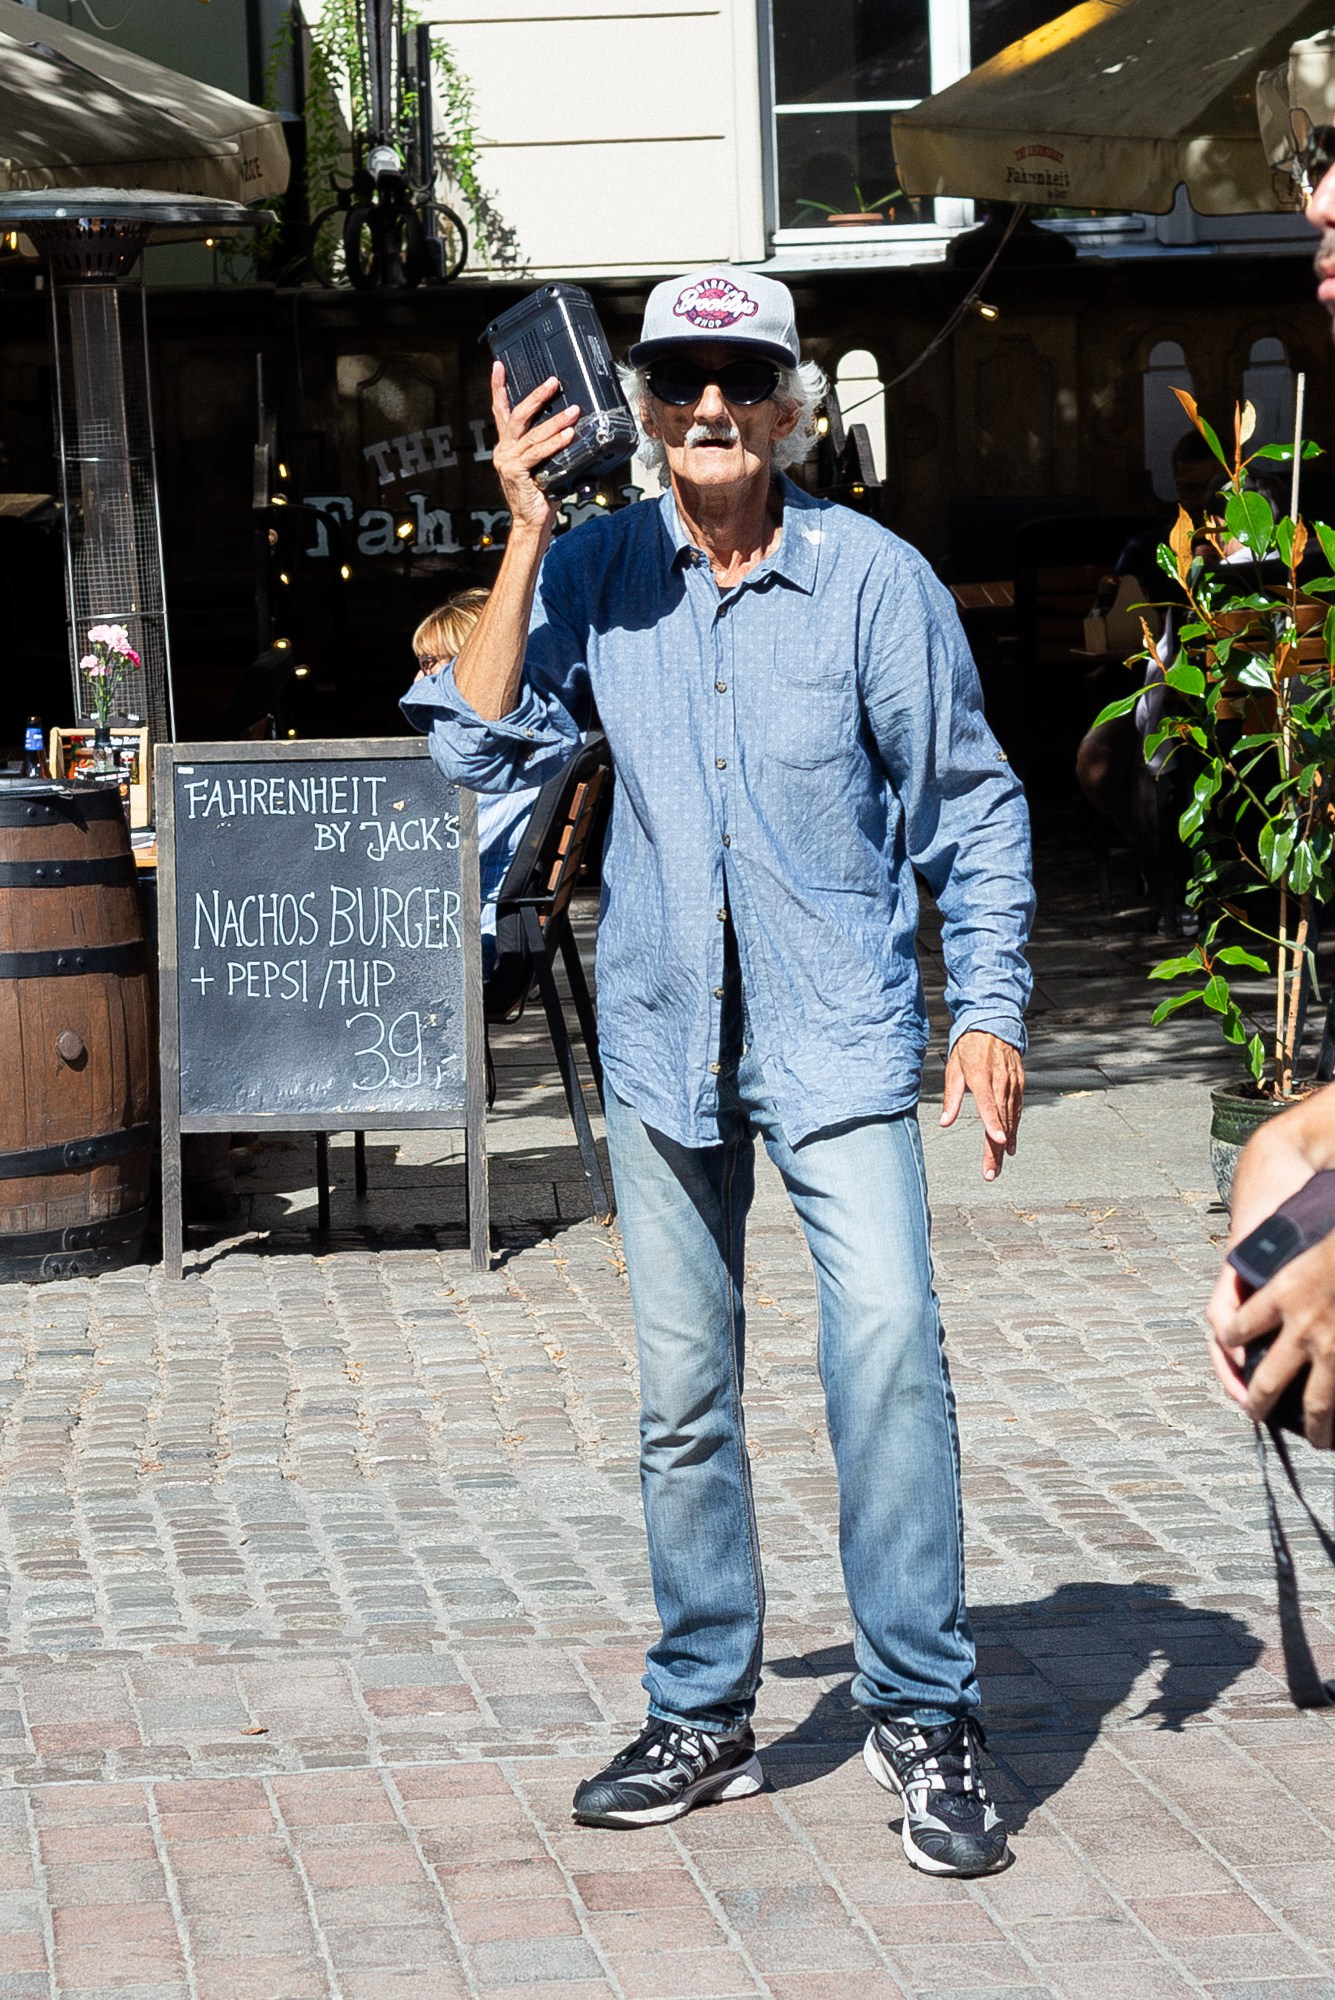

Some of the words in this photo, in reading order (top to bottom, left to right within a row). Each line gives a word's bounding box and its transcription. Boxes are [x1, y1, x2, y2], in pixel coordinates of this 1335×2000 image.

[694, 316, 722, 328] SHOP
[363, 425, 458, 486] THE
[184, 776, 387, 819] FAHRENHEIT
[314, 820, 351, 852] BY
[359, 812, 460, 861] JACK'S
[193, 889, 319, 950] NACHOS
[329, 884, 462, 950] BURGER
[228, 959, 309, 1003] PEPSI
